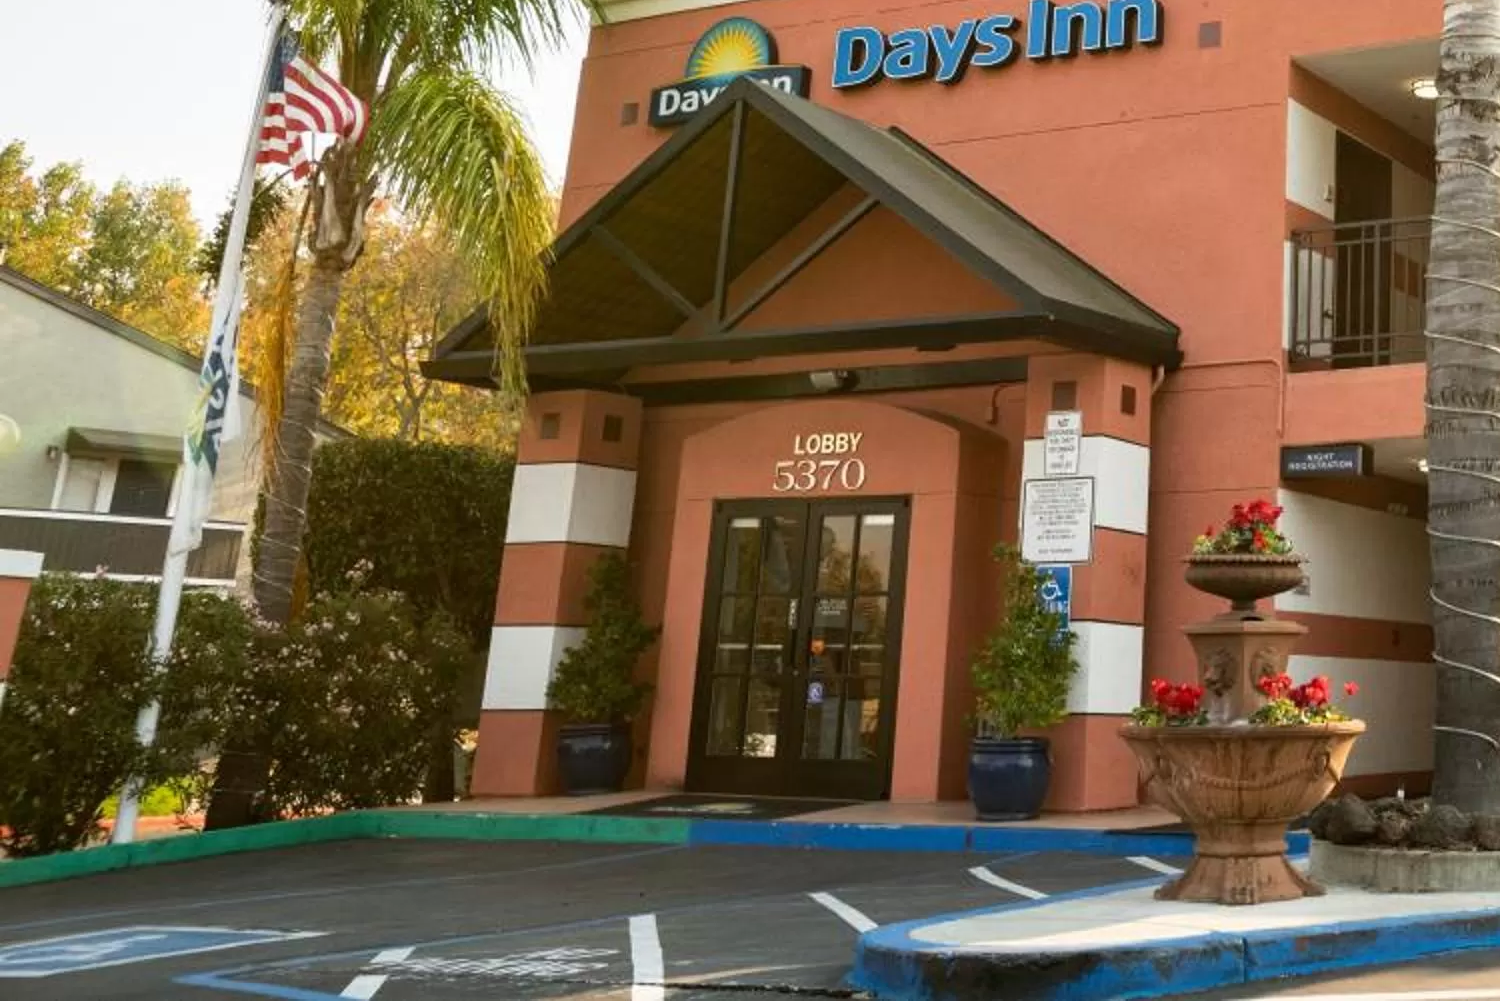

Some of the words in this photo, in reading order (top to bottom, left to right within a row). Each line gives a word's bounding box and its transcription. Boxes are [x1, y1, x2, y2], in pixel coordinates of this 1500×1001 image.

[832, 15, 1015, 89] Days
[657, 86, 728, 117] Day
[793, 431, 863, 455] LOBBY
[772, 458, 866, 492] 5370
